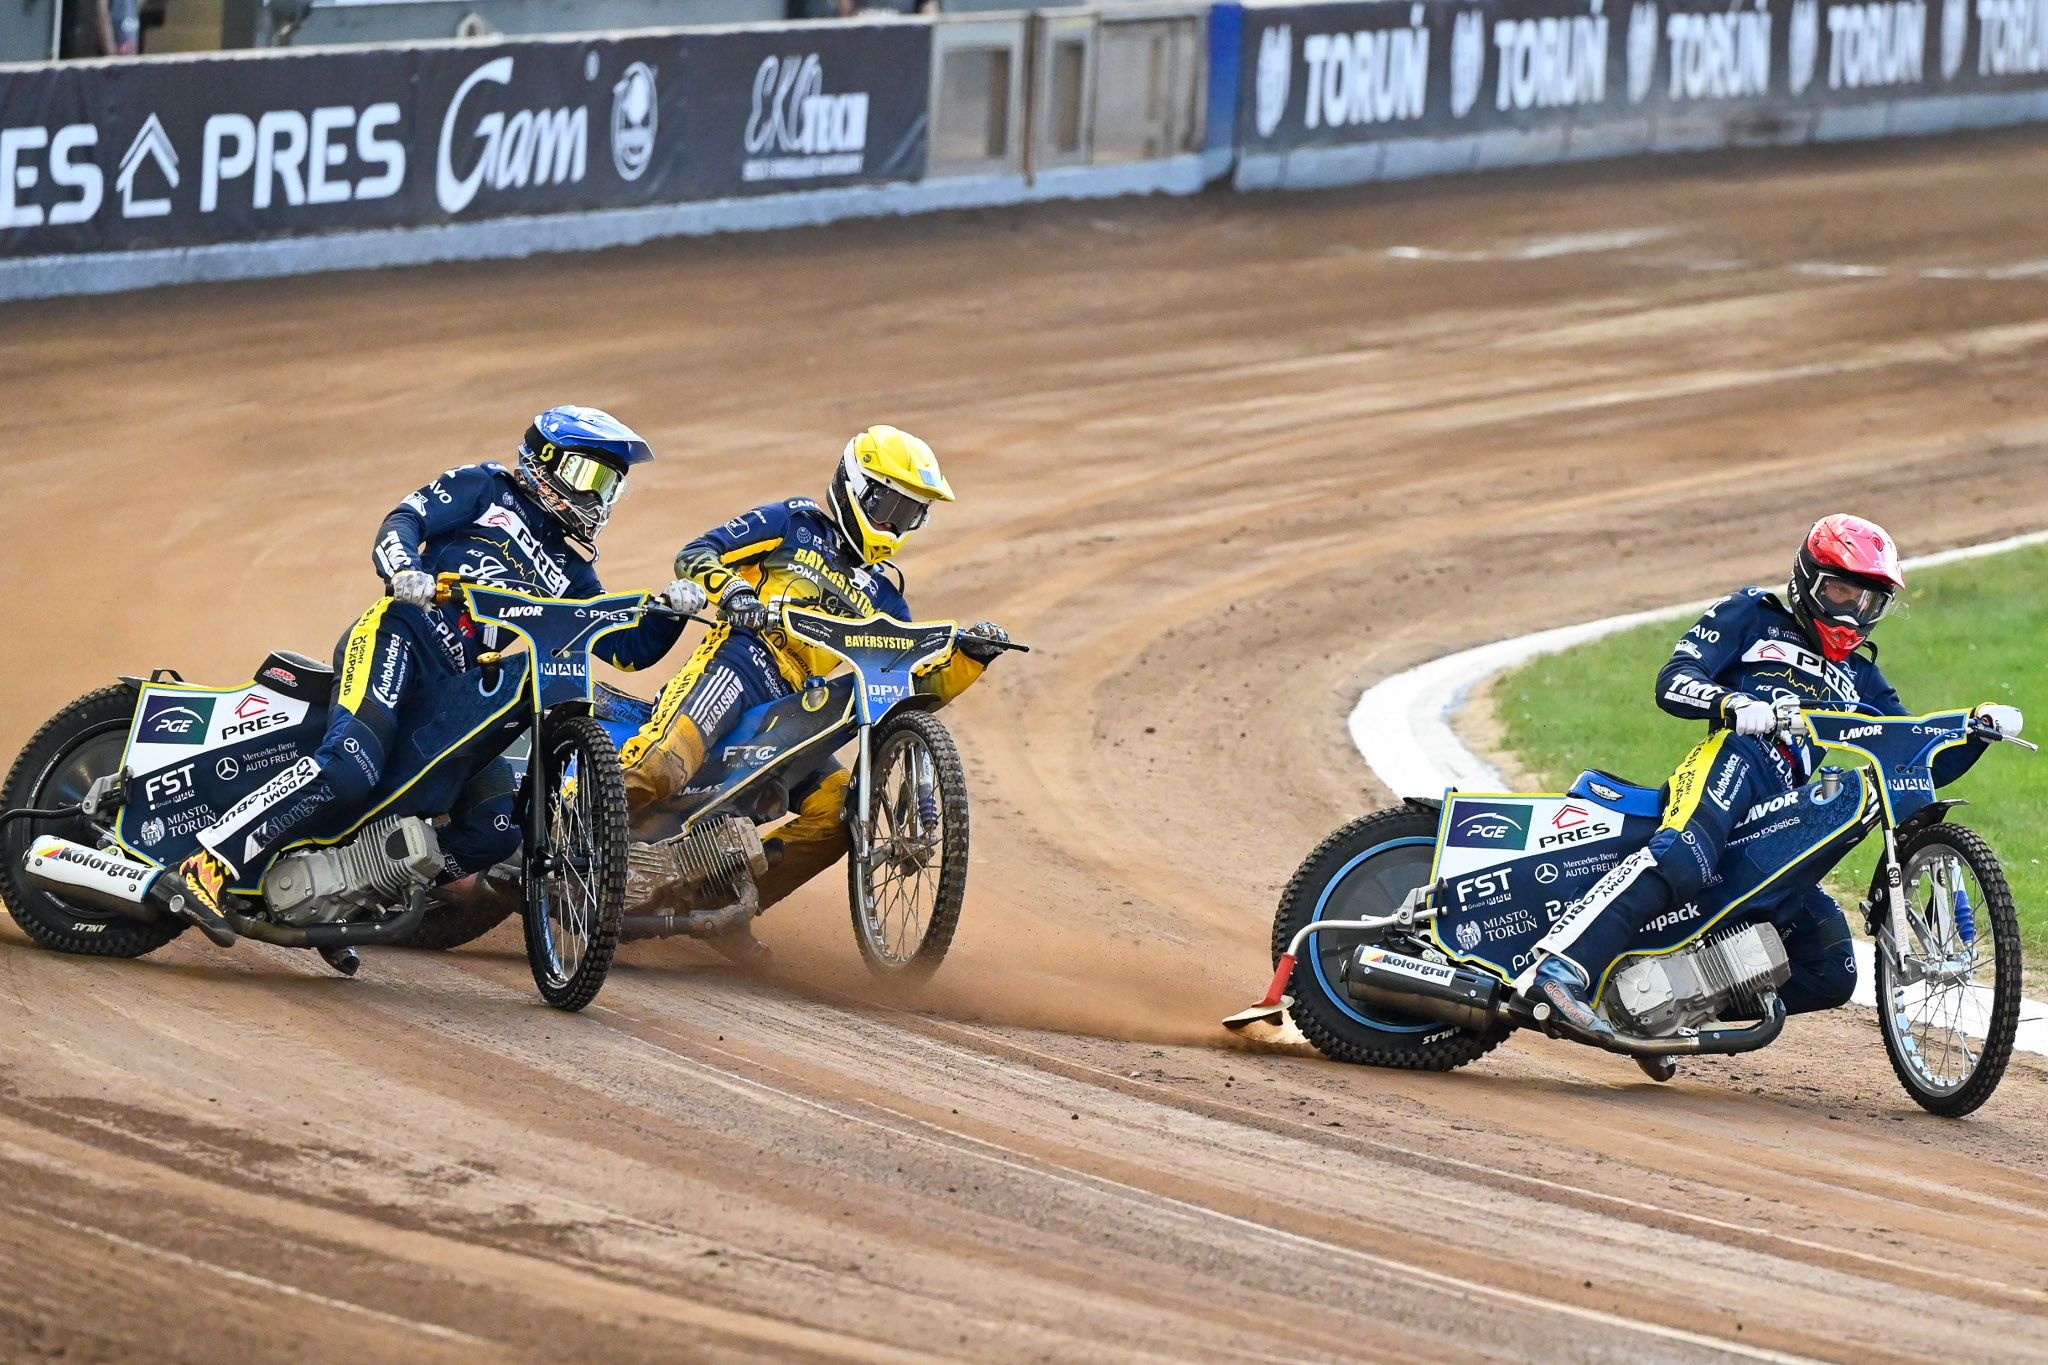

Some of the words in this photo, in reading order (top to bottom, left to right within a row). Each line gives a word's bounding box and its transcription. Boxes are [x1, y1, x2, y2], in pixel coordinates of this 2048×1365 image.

[1304, 3, 1430, 129] TORUŃ
[436, 56, 589, 213] Gam
[201, 102, 406, 212] PRES
[498, 605, 543, 618] LAVOR
[590, 610, 629, 622] PRES
[844, 635, 915, 650] BAYERSYSTEM
[343, 645, 359, 696] EXPOBUD
[154, 718, 193, 733] PGE
[222, 711, 290, 740] PRES
[1839, 724, 1882, 741] LAVOR
[242, 741, 296, 762] Mercedes-Benz
[245, 759, 268, 773] AUTO
[270, 750, 299, 767] FRELIK
[354, 754, 367, 771] AUTO
[145, 763, 195, 802] FST
[263, 780, 298, 807] DOMY
[167, 803, 209, 826] MIASTO
[168, 809, 217, 838] TORUŃ
[1466, 824, 1509, 839] PGE
[1539, 822, 1611, 849] PRES
[1760, 816, 1800, 836] logistics
[58, 847, 150, 881] Kolorgraf
[1563, 852, 1618, 869] Mercedes-Benz
[1690, 846, 1703, 863] AUTO
[1565, 866, 1590, 878] AUTO
[1602, 867, 1632, 898] DOMY
[1889, 869, 1901, 886] SR
[1456, 867, 1513, 903] FST
[1468, 902, 1486, 910] Grupa
[72, 922, 107, 933] ANLAS
[1483, 909, 1528, 930] MIASTO
[1485, 915, 1538, 942] TORUŃ
[1382, 954, 1450, 979] Kolorgraf
[1422, 1025, 1461, 1045] ANLAS
